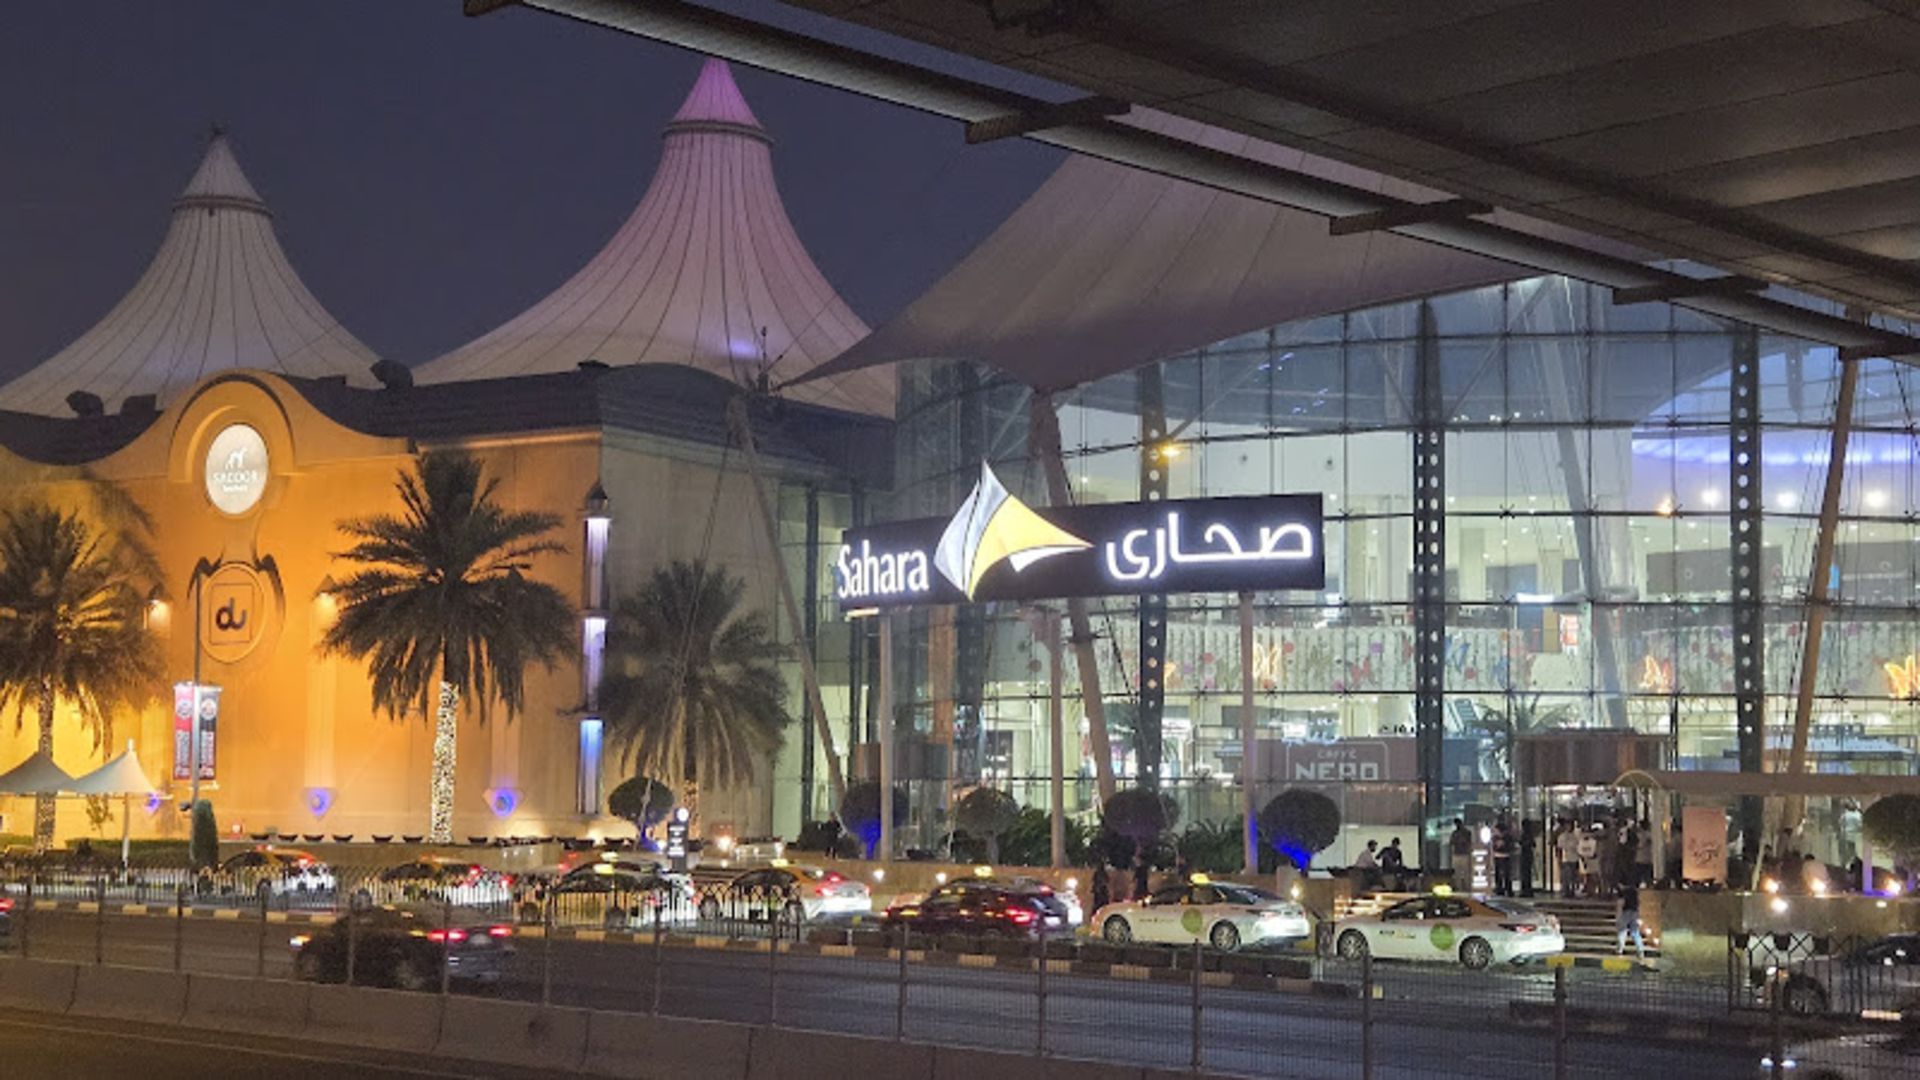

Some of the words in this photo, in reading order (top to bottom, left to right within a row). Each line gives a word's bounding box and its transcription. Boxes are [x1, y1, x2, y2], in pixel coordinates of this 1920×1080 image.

[838, 539, 929, 598] Sahara
[216, 597, 247, 631] du
[1295, 762, 1378, 780] NERO
